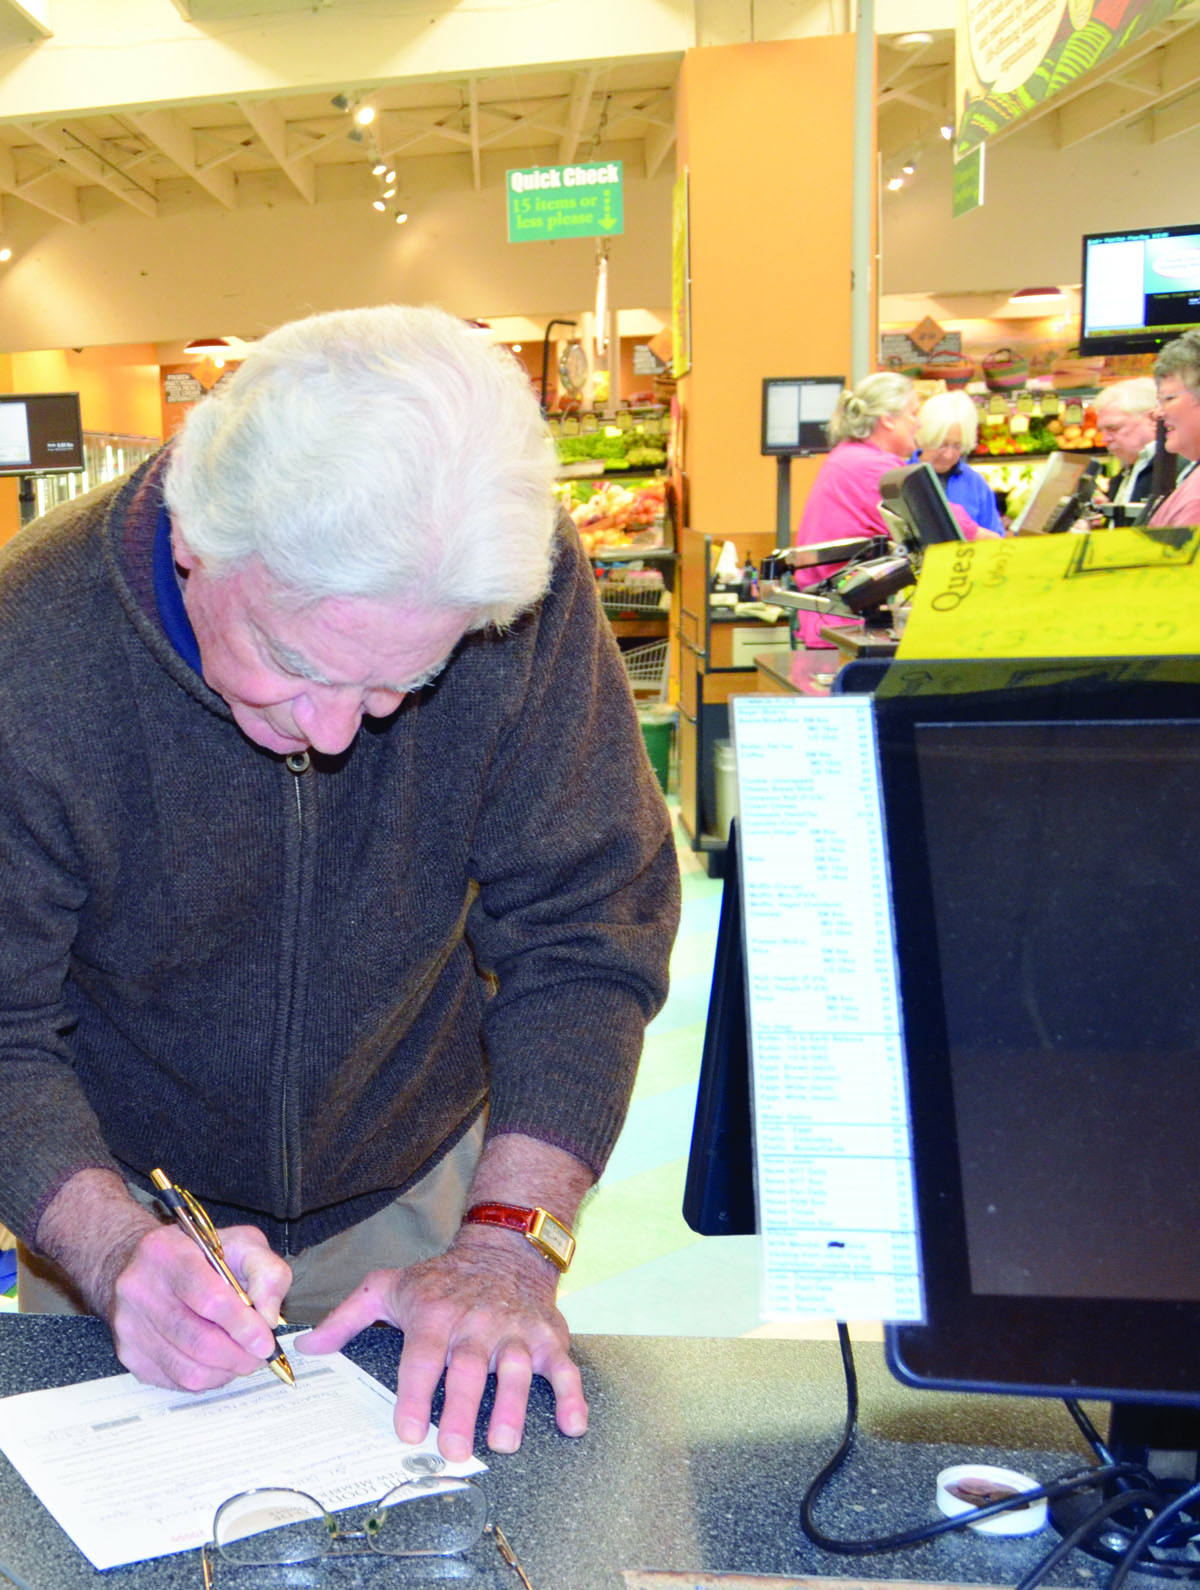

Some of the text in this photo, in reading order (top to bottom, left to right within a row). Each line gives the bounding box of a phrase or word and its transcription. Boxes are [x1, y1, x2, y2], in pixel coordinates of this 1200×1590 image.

[511, 163, 619, 193] Quick Check
[513, 196, 598, 213] 15 items or
[517, 211, 594, 232] less please
[931, 541, 977, 612] Ques
